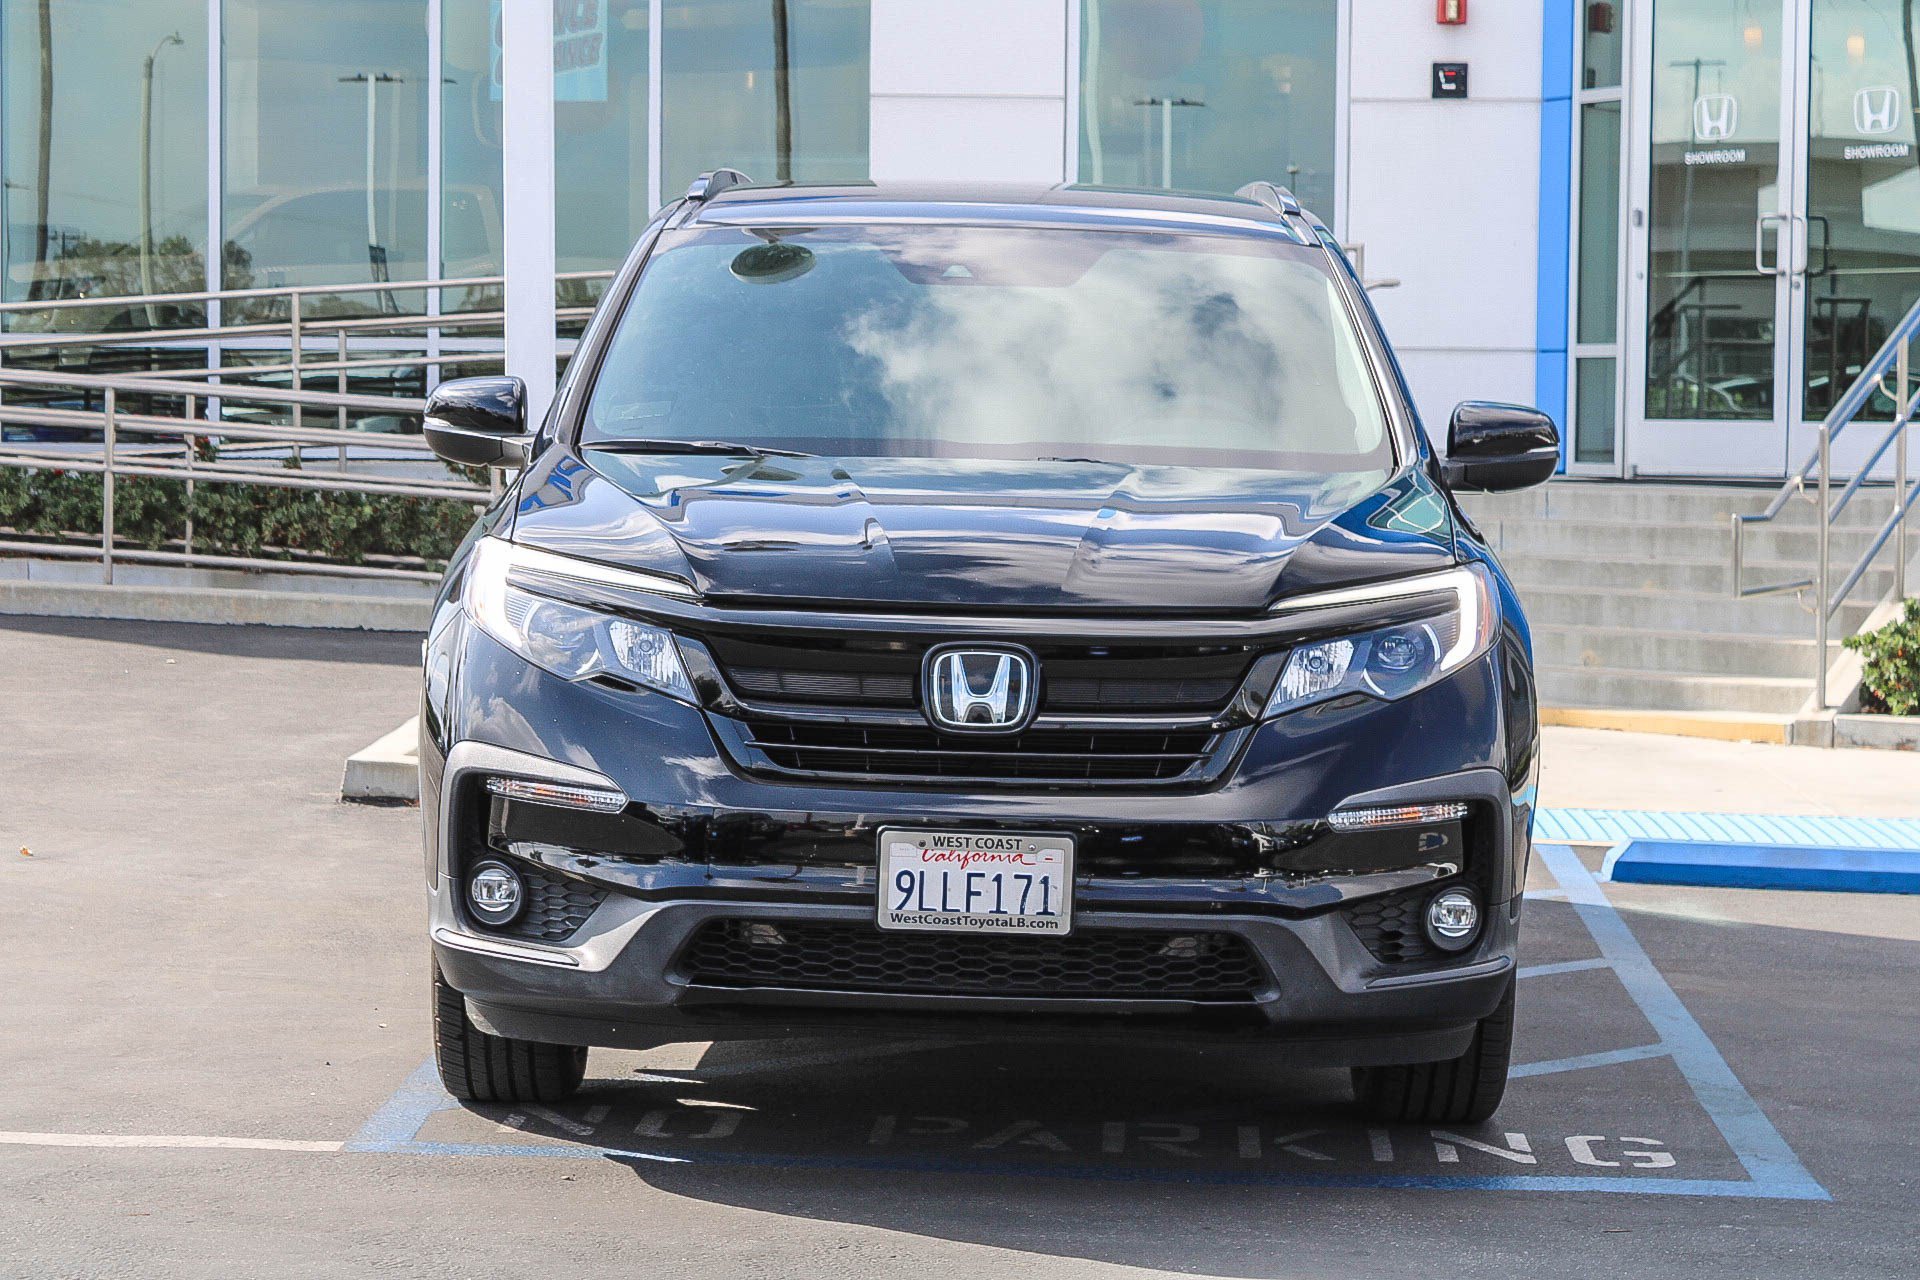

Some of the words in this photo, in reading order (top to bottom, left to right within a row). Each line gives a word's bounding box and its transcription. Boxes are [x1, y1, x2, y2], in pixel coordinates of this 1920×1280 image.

[1684, 149, 1746, 165] SHOWROOM
[1843, 143, 1910, 160] SHOWROOM
[932, 835, 973, 849] WEST
[974, 837, 1023, 851] COAST
[921, 849, 1037, 871] California
[895, 869, 1056, 916] 9LLF171
[890, 912, 1059, 930] WestCoastToyotaLB.com
[867, 1113, 1677, 1169] PARKING
